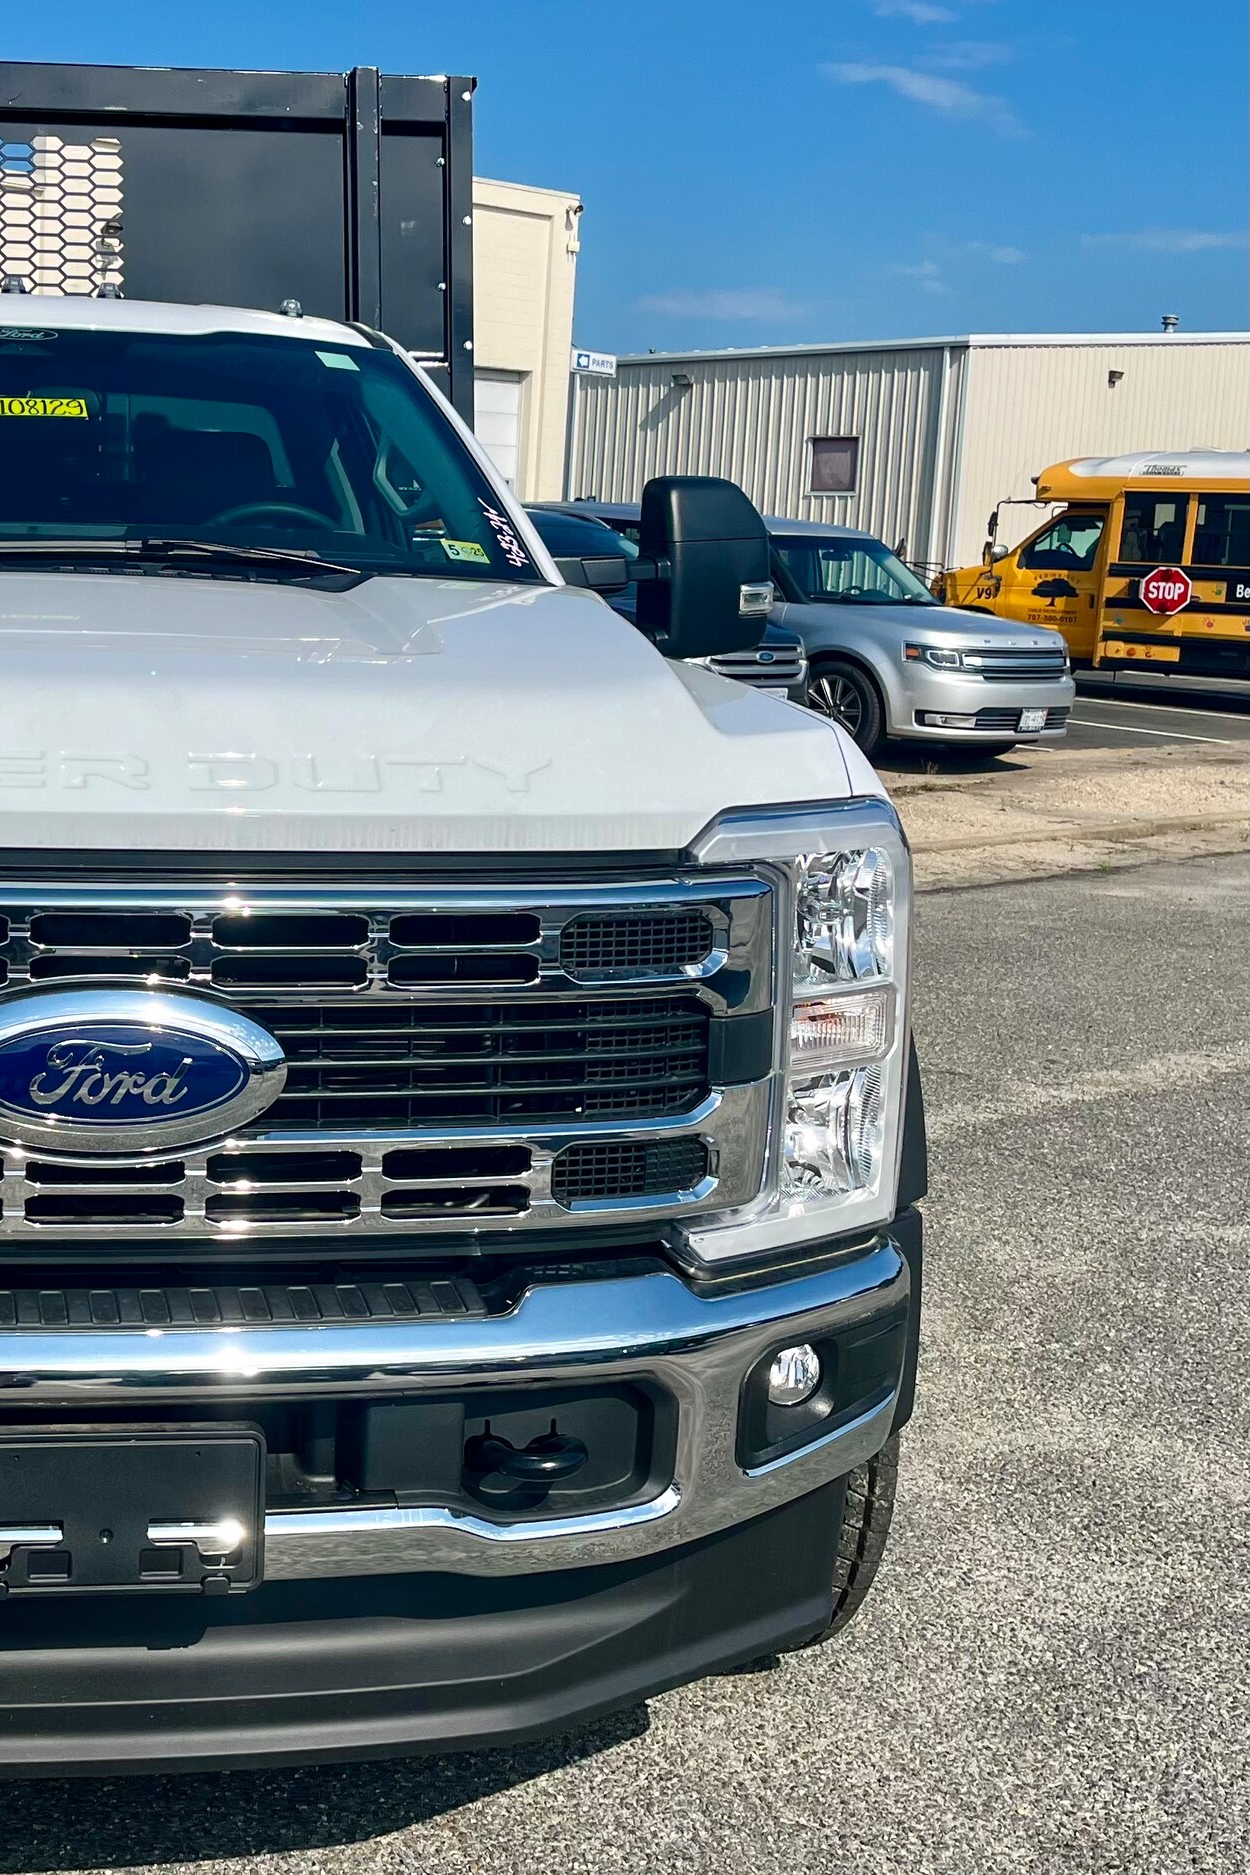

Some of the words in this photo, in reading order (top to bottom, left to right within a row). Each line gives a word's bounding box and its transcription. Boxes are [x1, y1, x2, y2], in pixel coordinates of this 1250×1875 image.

[591, 359, 614, 370] PARTS
[448, 545, 460, 556] 5
[1148, 582, 1185, 600] STOP
[186, 751, 554, 794] DUTY
[29, 1039, 193, 1105] Ford
